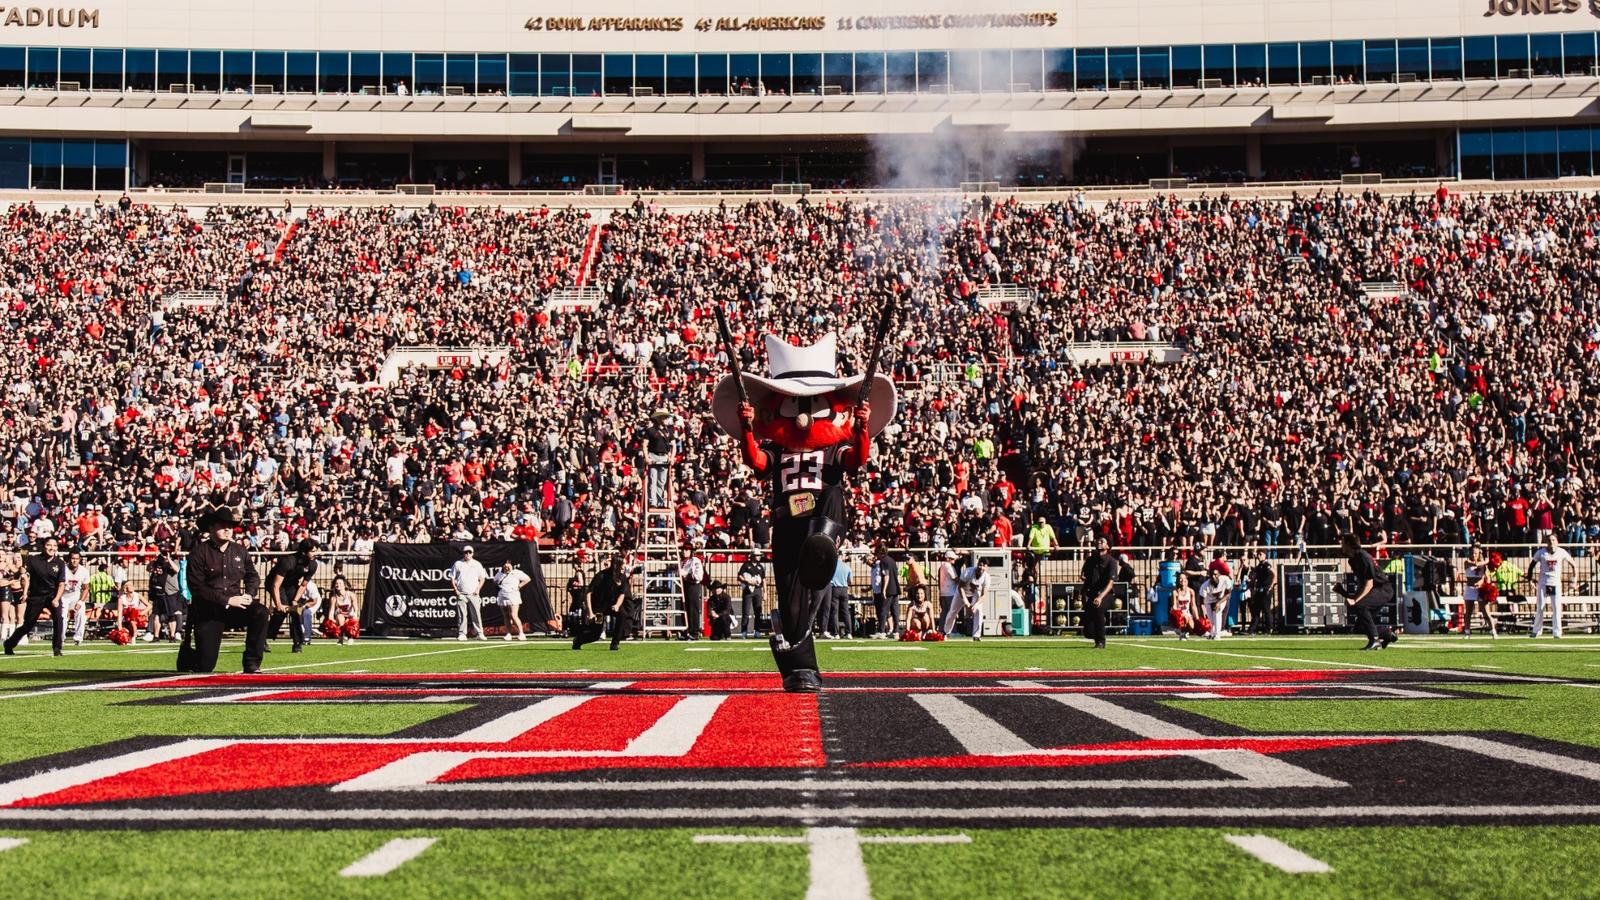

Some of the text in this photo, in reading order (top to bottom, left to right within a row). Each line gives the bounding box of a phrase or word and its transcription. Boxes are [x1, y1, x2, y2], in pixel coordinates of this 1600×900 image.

[524, 17, 684, 31] 42 BOWL APPEARANCES
[715, 16, 826, 31] ALL-AMERICANS
[836, 16, 853, 31] 11
[855, 15, 941, 30] CONFERENCE
[780, 450, 824, 493] 23
[408, 596, 447, 607] Jewett
